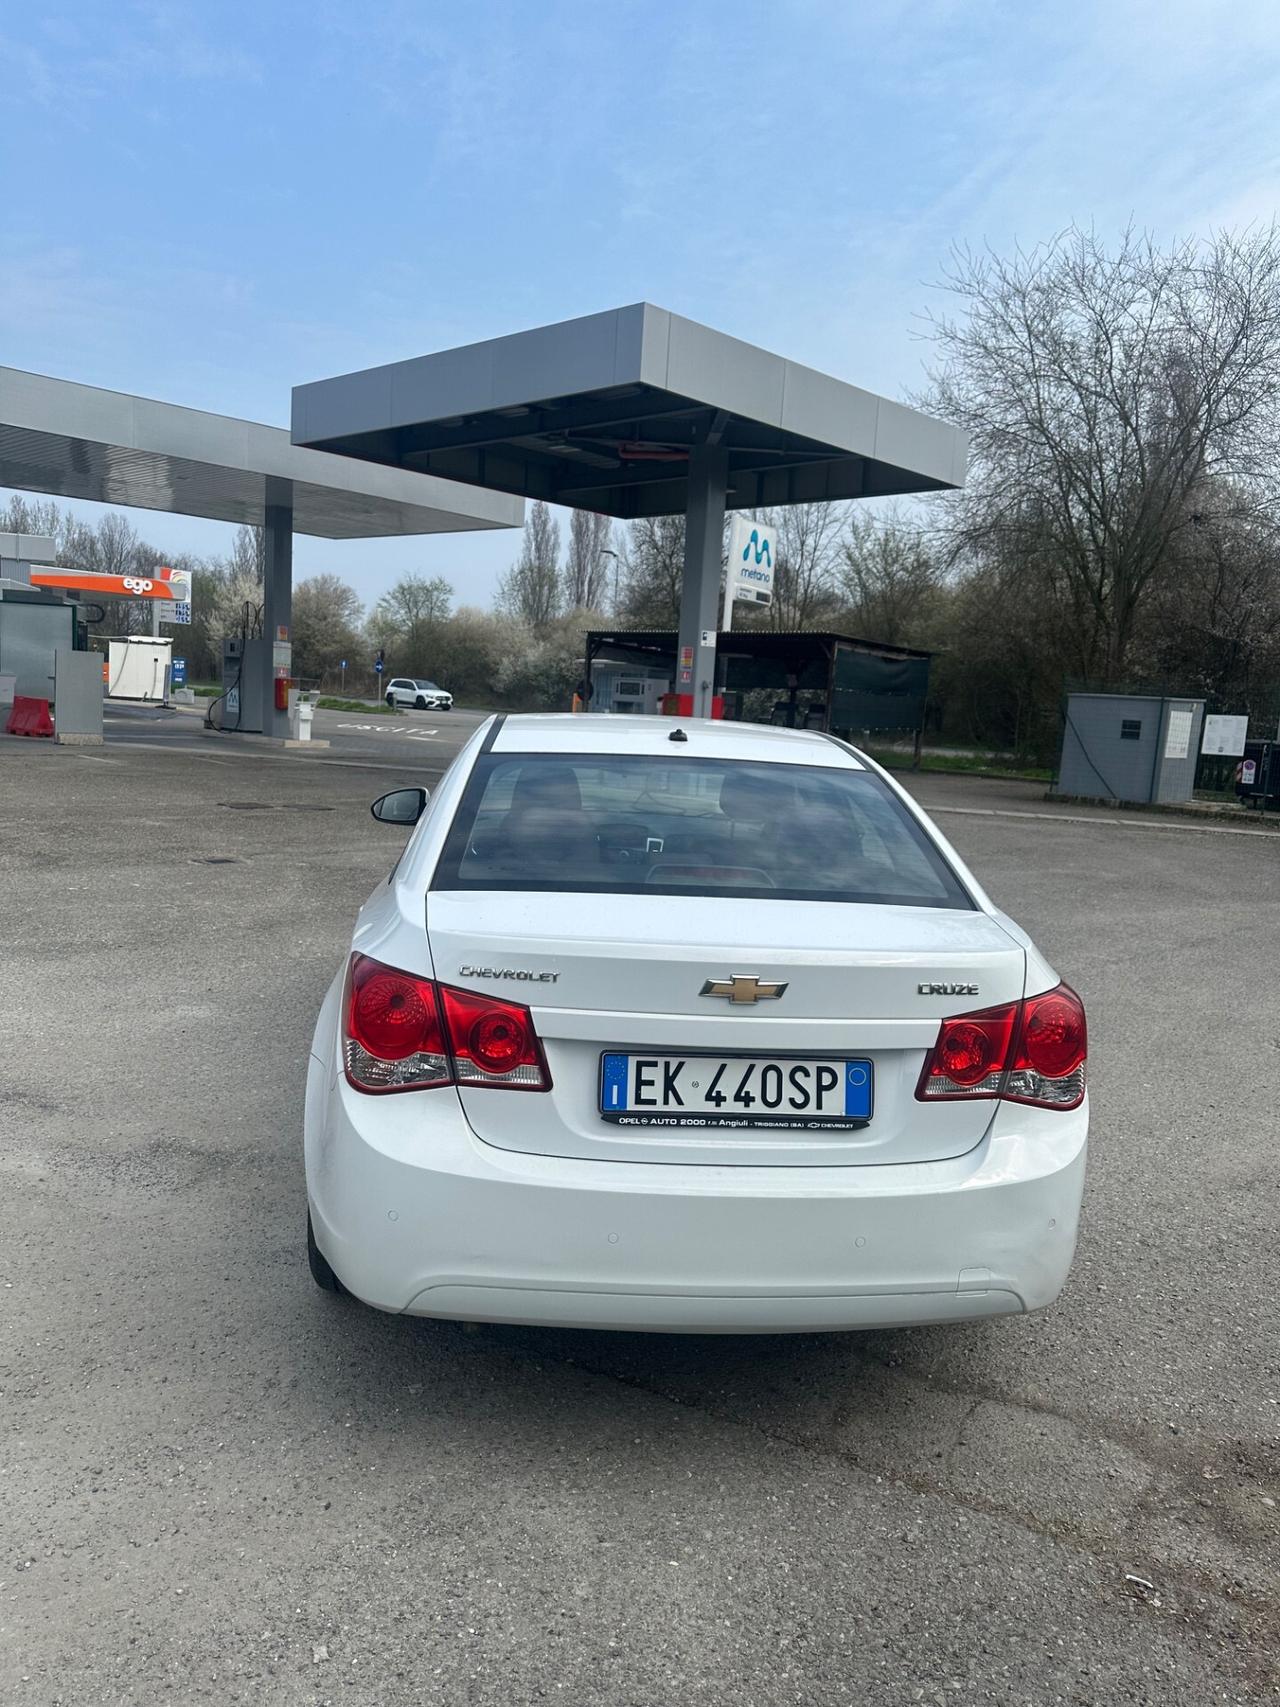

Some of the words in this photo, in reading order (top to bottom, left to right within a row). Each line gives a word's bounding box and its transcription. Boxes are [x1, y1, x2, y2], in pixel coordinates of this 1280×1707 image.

[741, 568, 770, 583] metano
[123, 578, 153, 595] ego
[337, 724, 439, 735] USCITA
[459, 966, 561, 984] CHEVROLET
[918, 983, 979, 996] CRUZE
[634, 1060, 687, 1107] EK
[705, 1063, 839, 1111] 440SP
[618, 1117, 640, 1125] OPEL
[718, 1119, 749, 1128] Angiuli
